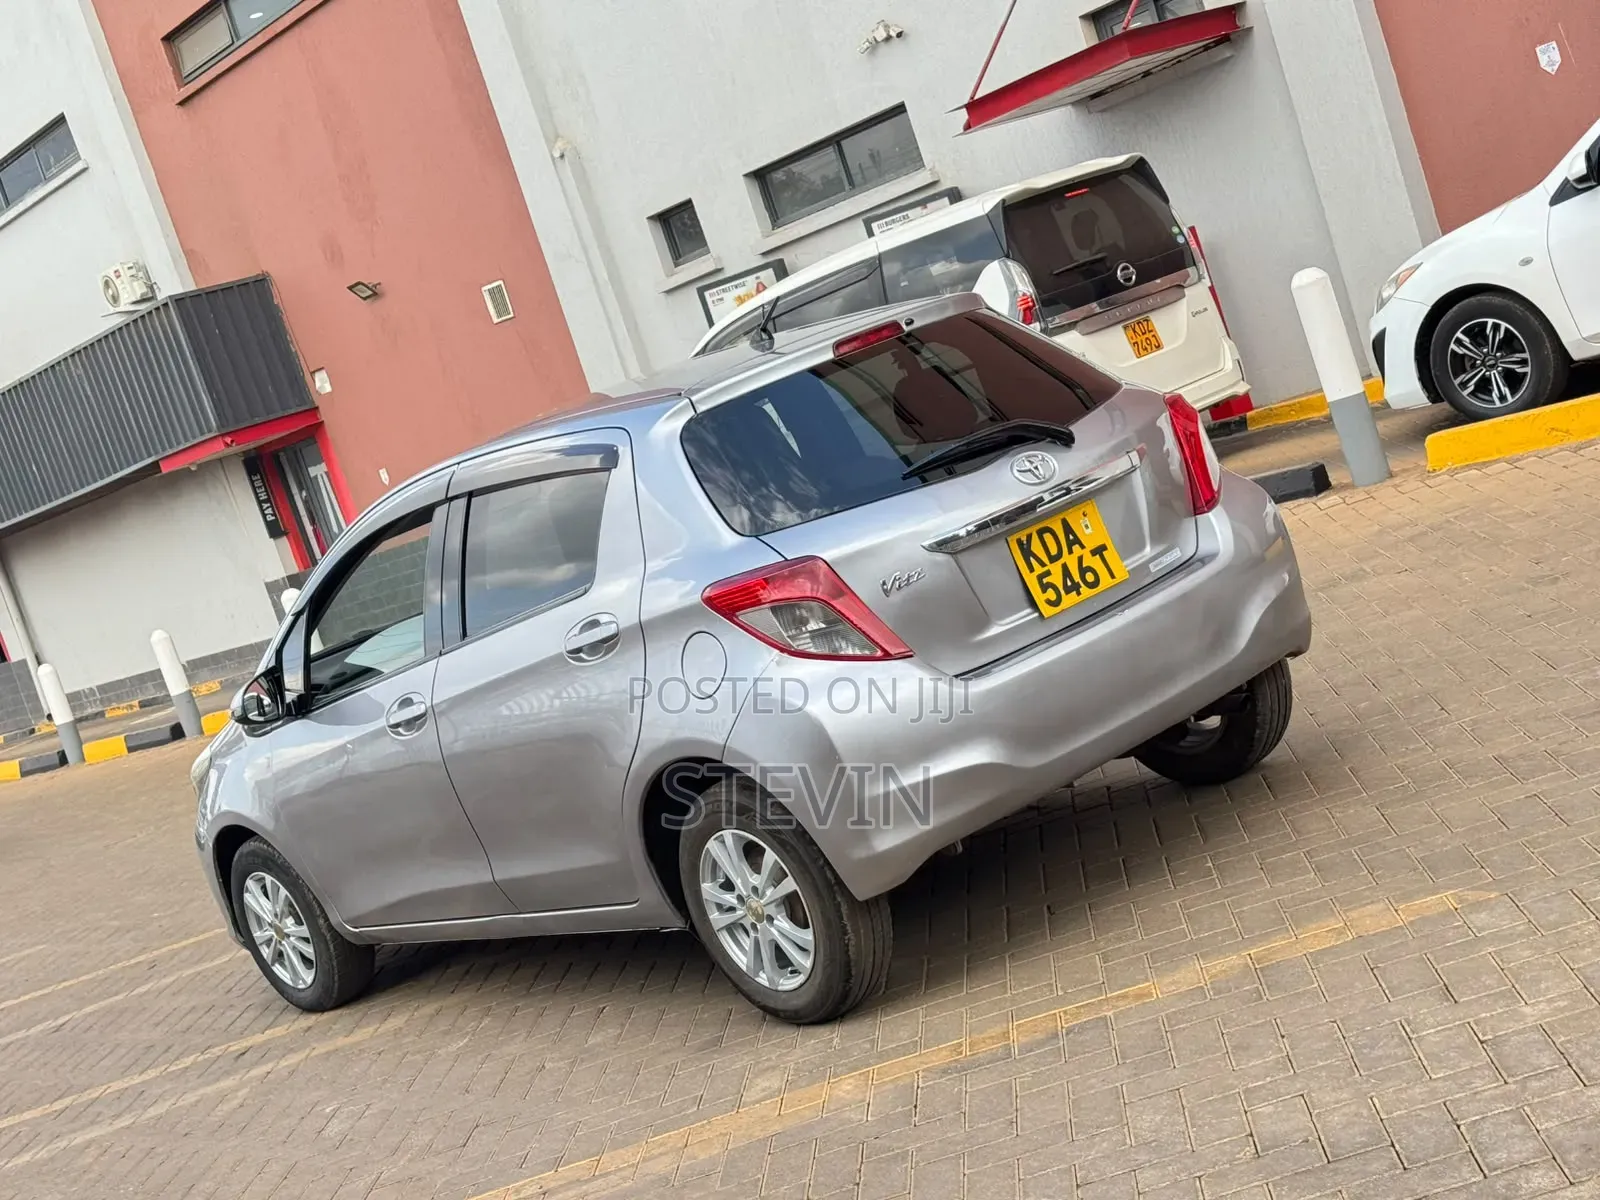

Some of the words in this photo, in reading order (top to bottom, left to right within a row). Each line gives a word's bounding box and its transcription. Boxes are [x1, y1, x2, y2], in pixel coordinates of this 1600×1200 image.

[885, 213, 910, 226] BURGERS
[1130, 319, 1154, 338] KDZ
[1133, 334, 1161, 355] 749J
[252, 474, 267, 500] HERE
[262, 503, 275, 521] PAY
[1015, 518, 1086, 573] KDA
[880, 568, 926, 598] Vitz
[1038, 544, 1117, 607] 546T
